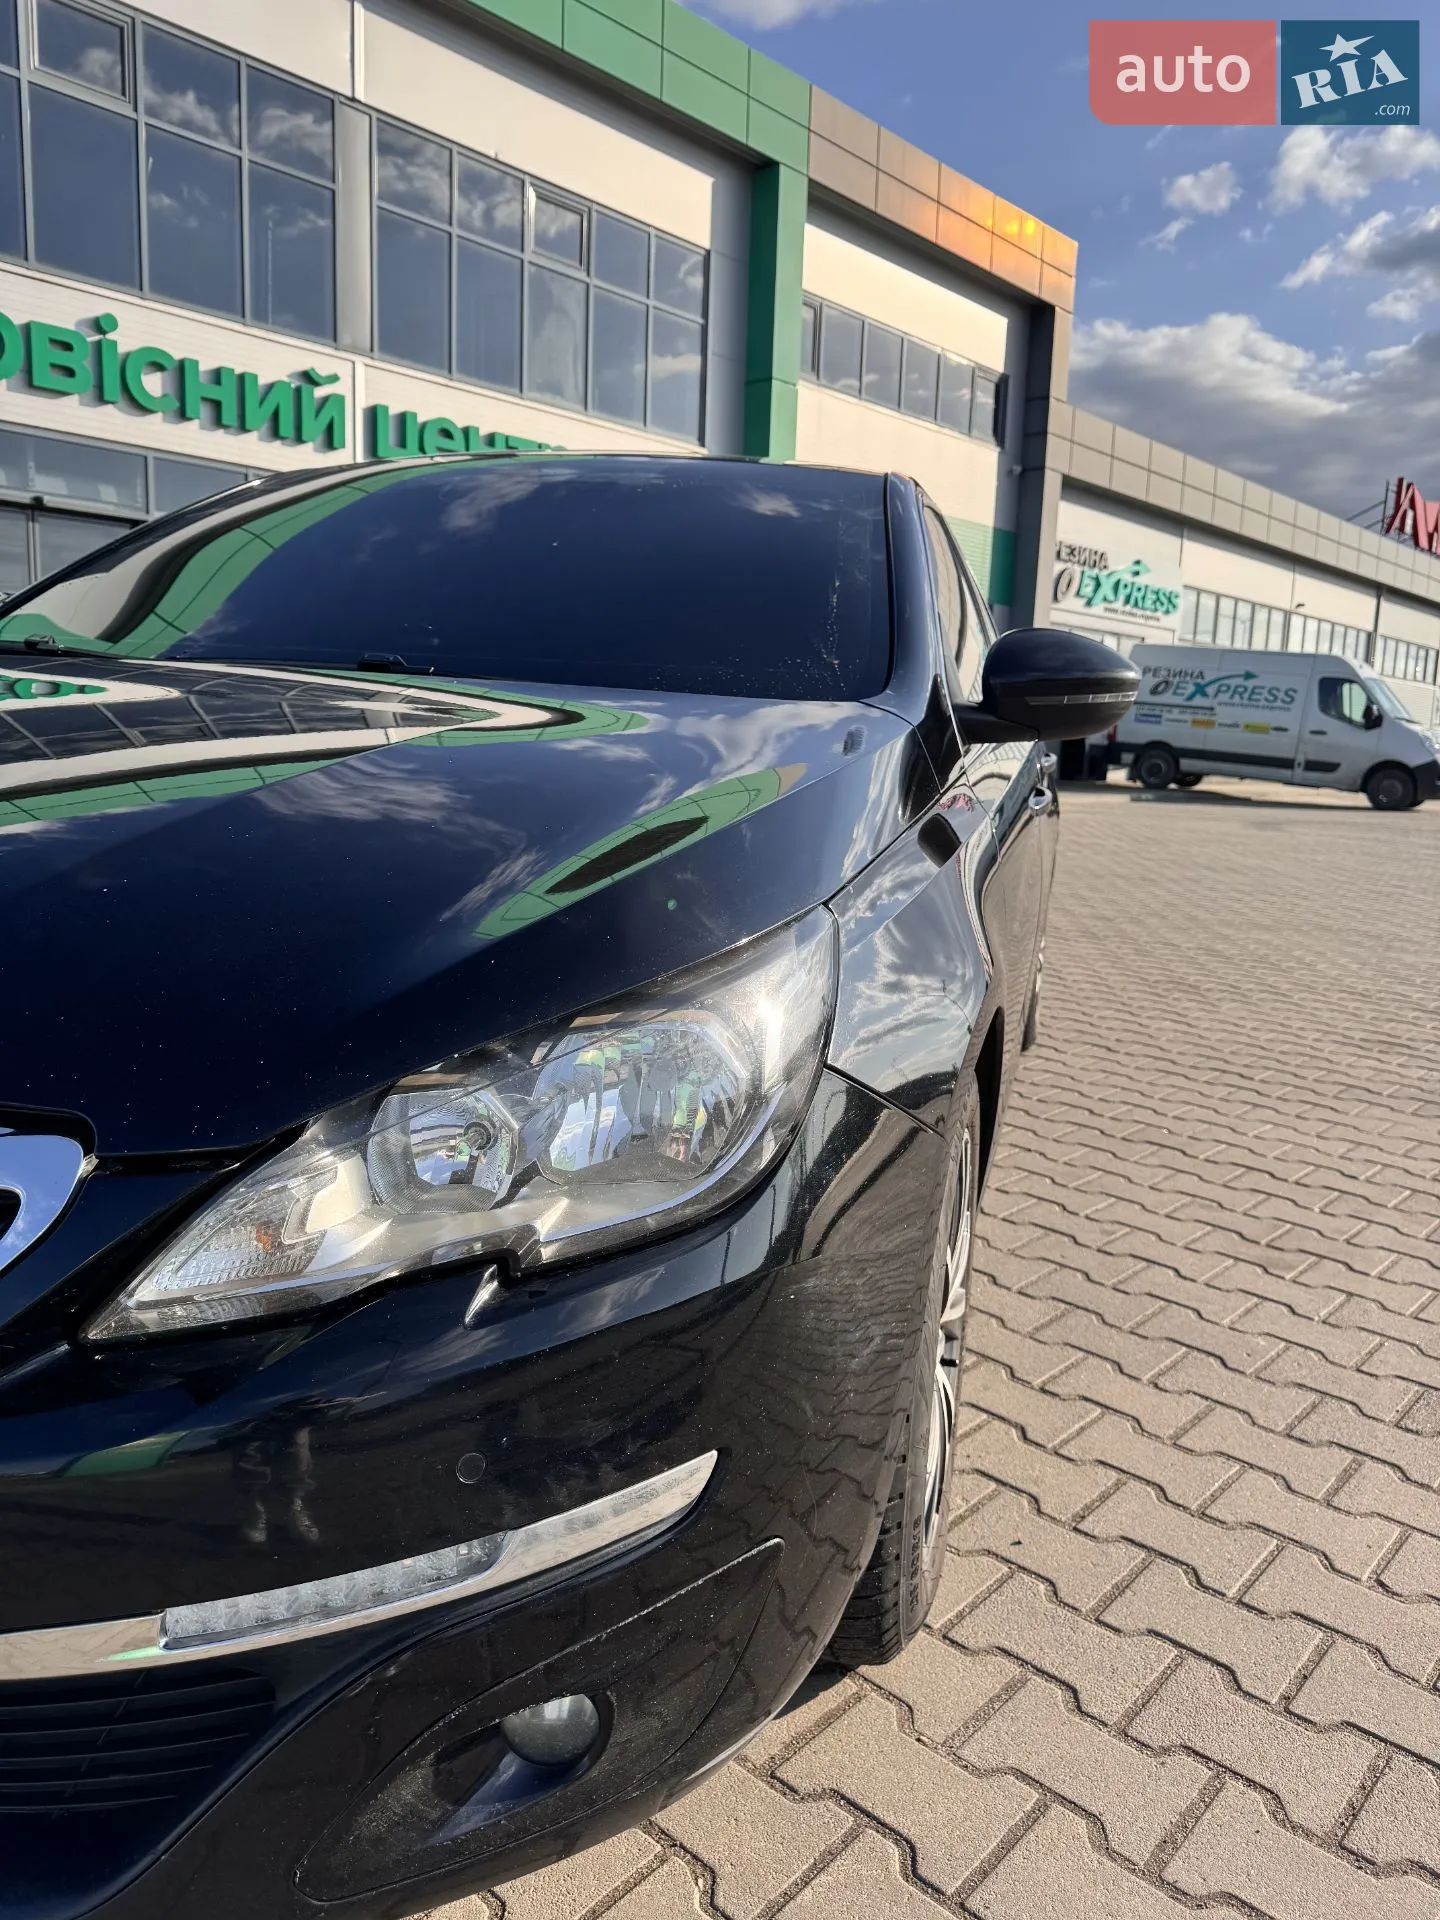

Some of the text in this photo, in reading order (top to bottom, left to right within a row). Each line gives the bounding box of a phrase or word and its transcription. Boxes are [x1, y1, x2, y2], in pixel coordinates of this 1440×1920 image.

[1055, 541, 1109, 571] ЕЗИНА
[1075, 569, 1181, 615] EXPRESS
[1142, 666, 1204, 680] РЕЗИНА
[1171, 680, 1298, 705] EXPRESS
